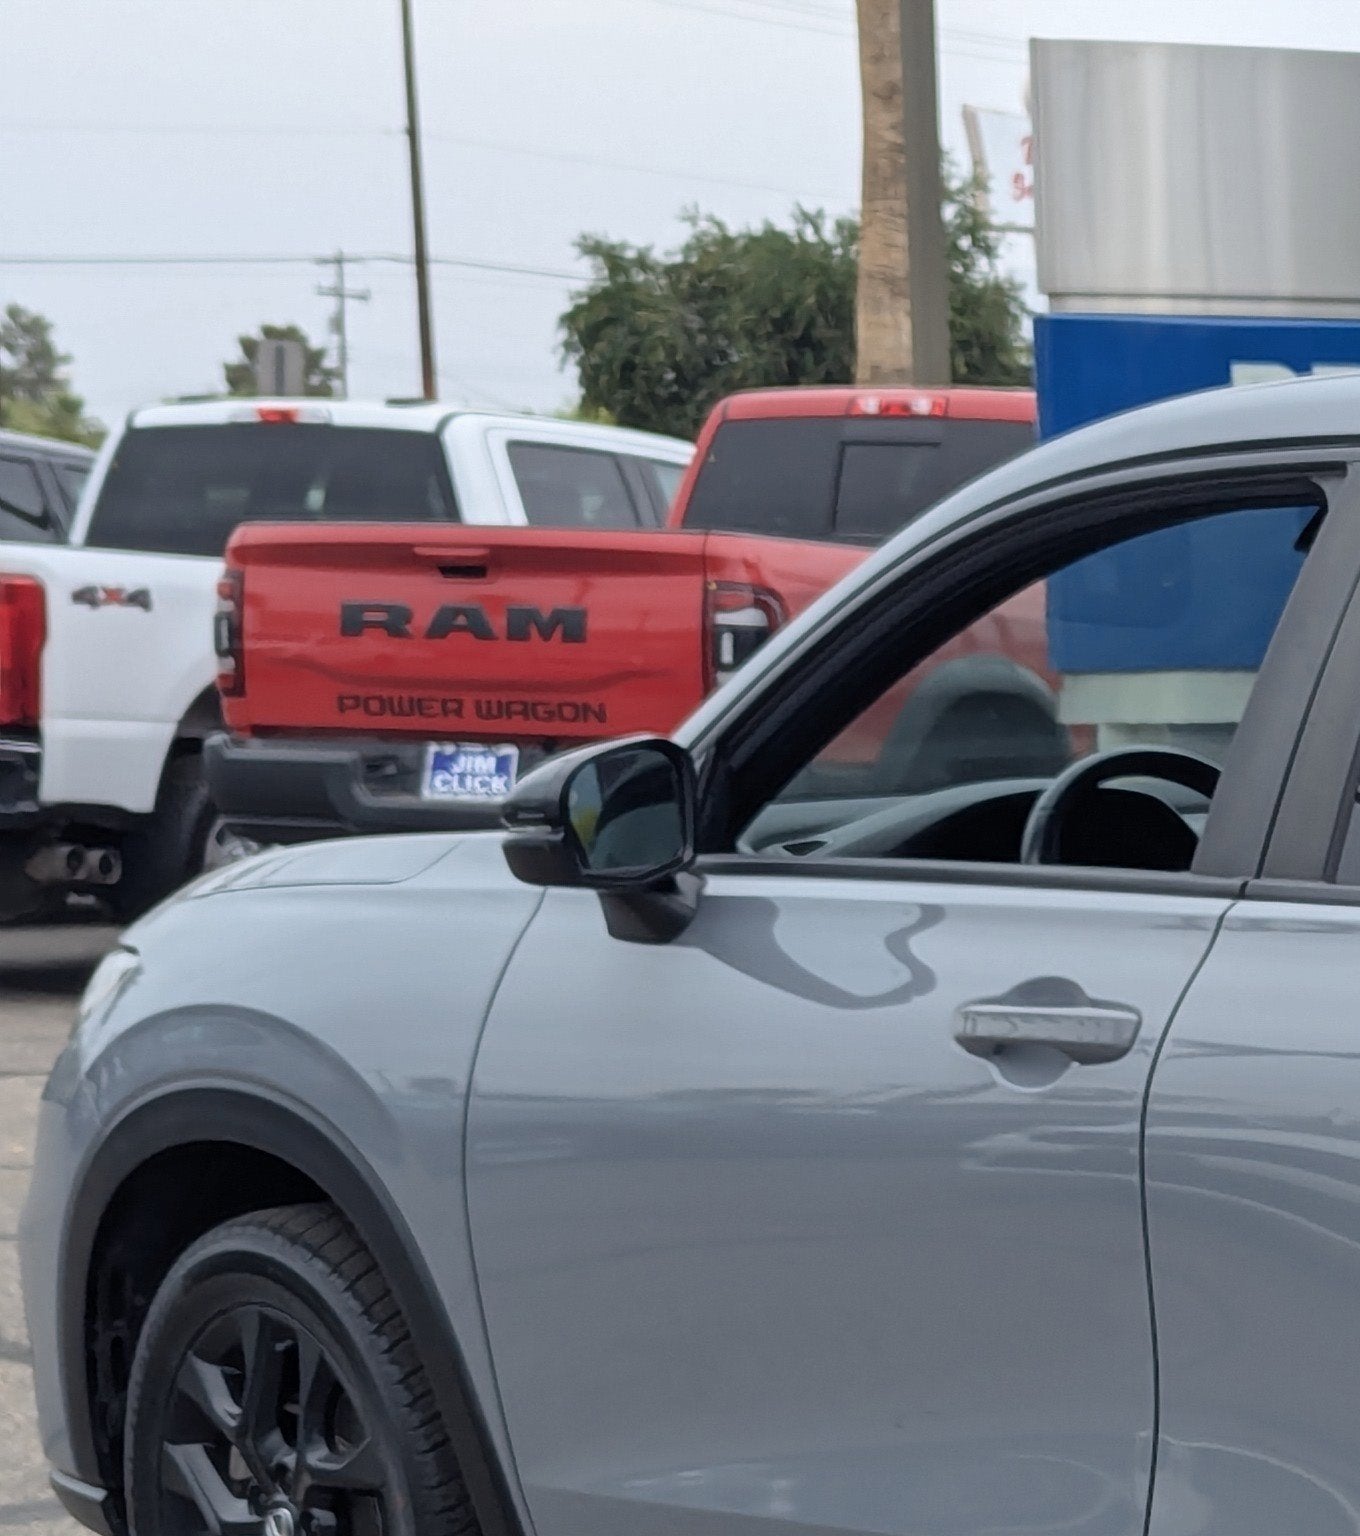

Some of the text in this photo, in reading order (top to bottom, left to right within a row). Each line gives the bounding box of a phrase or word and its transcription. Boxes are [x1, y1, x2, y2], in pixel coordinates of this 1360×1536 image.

[340, 603, 588, 642] RAM
[337, 694, 607, 724] POWER WAGON
[450, 753, 497, 774] JIM
[433, 770, 508, 794] CLICK
